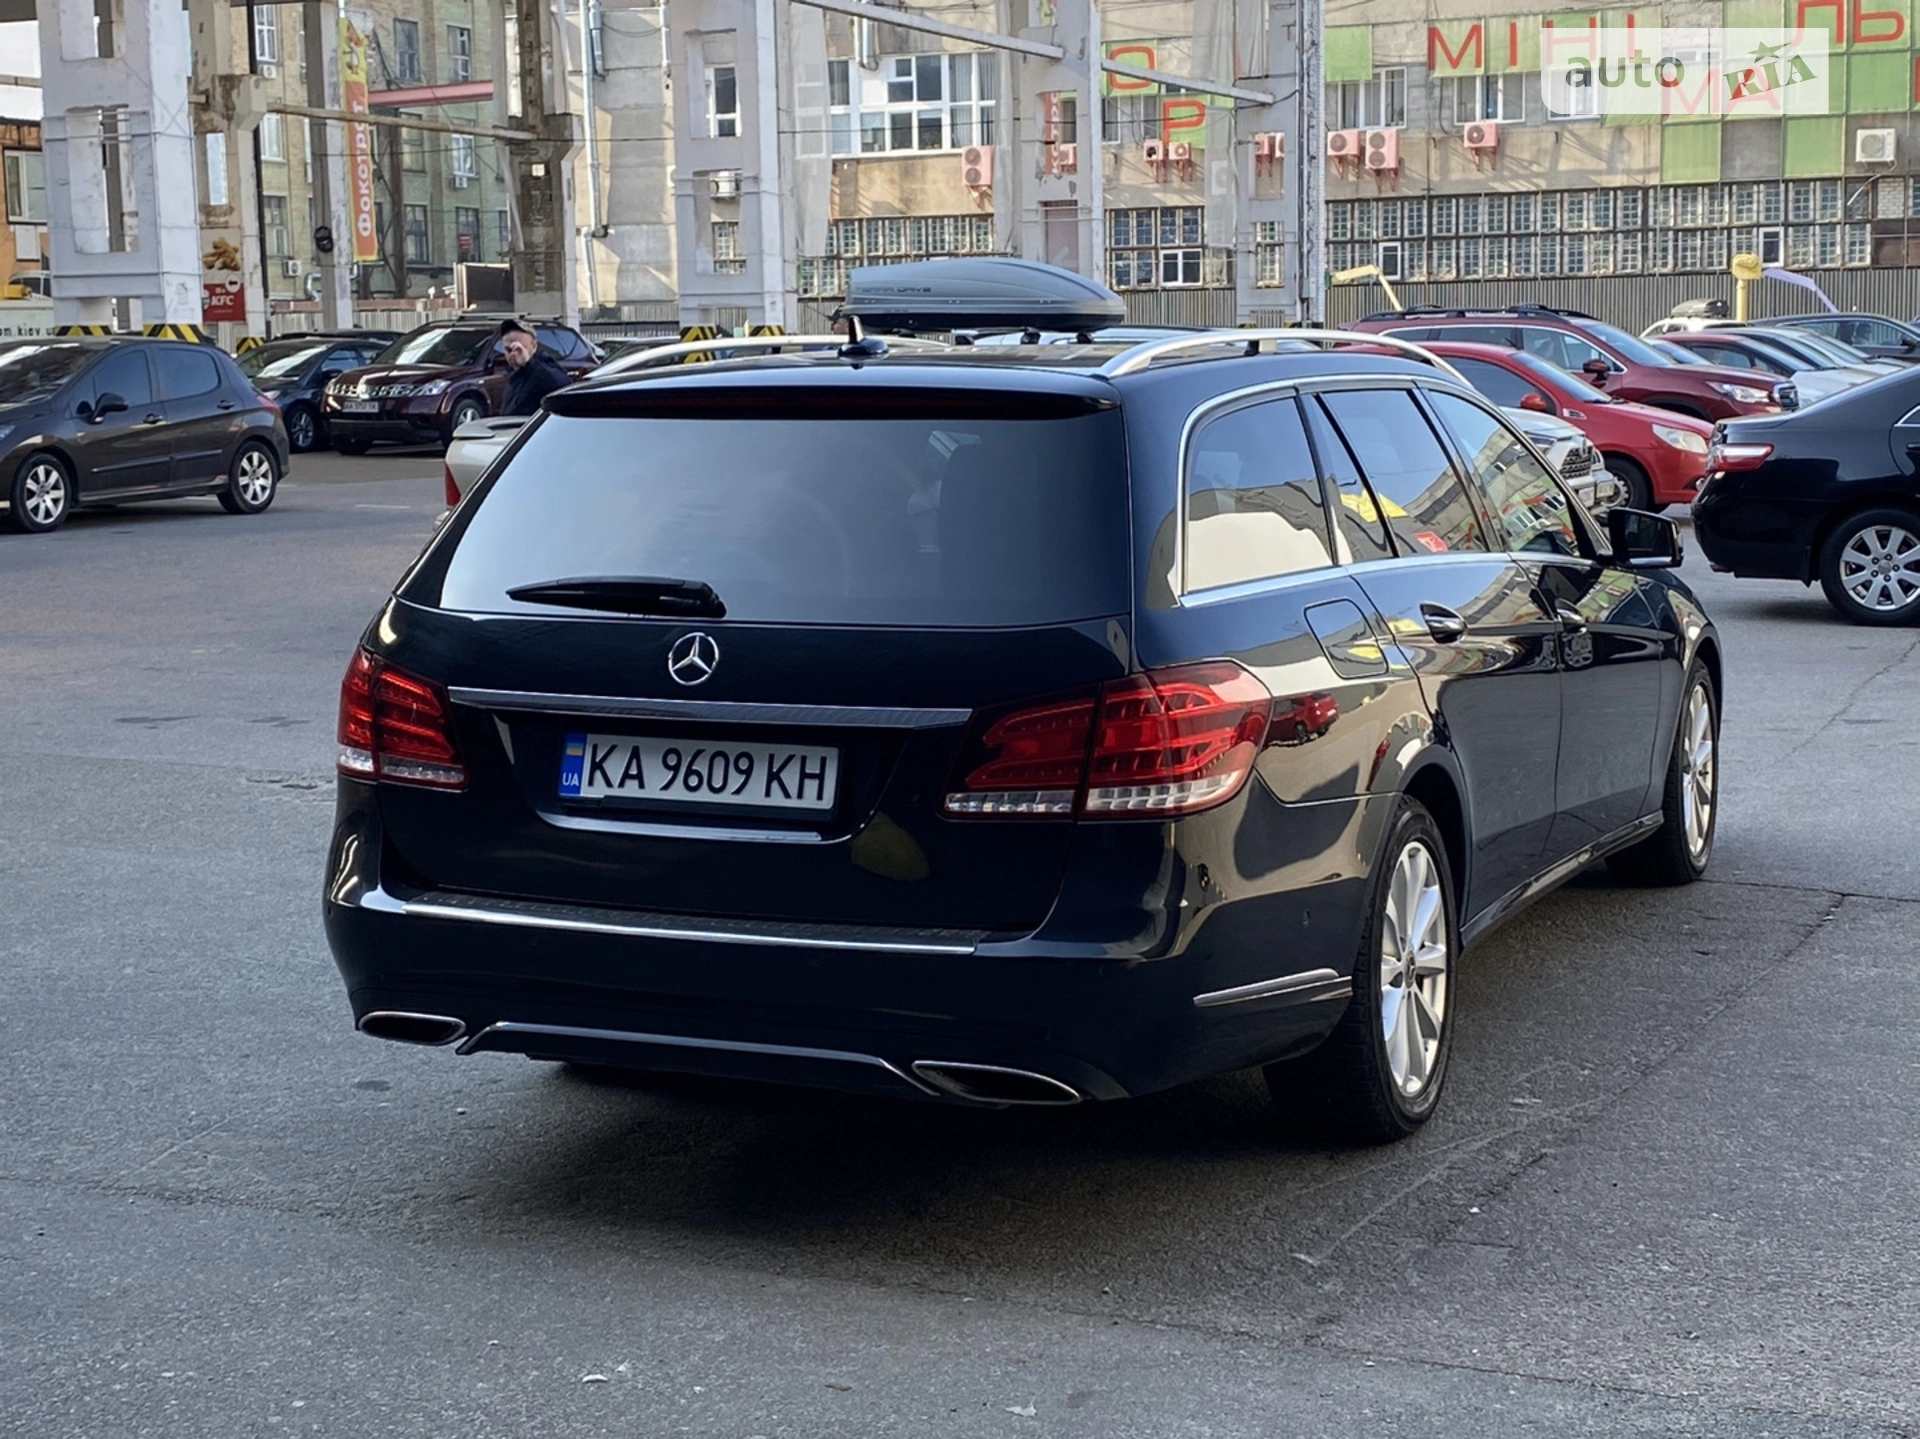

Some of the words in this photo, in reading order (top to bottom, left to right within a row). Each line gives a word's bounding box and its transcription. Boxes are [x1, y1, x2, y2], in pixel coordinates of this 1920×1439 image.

[211, 294, 235, 307] KFC
[562, 772, 580, 787] UA
[587, 743, 646, 790] KA
[659, 747, 755, 796] 9609
[764, 752, 828, 801] KH
